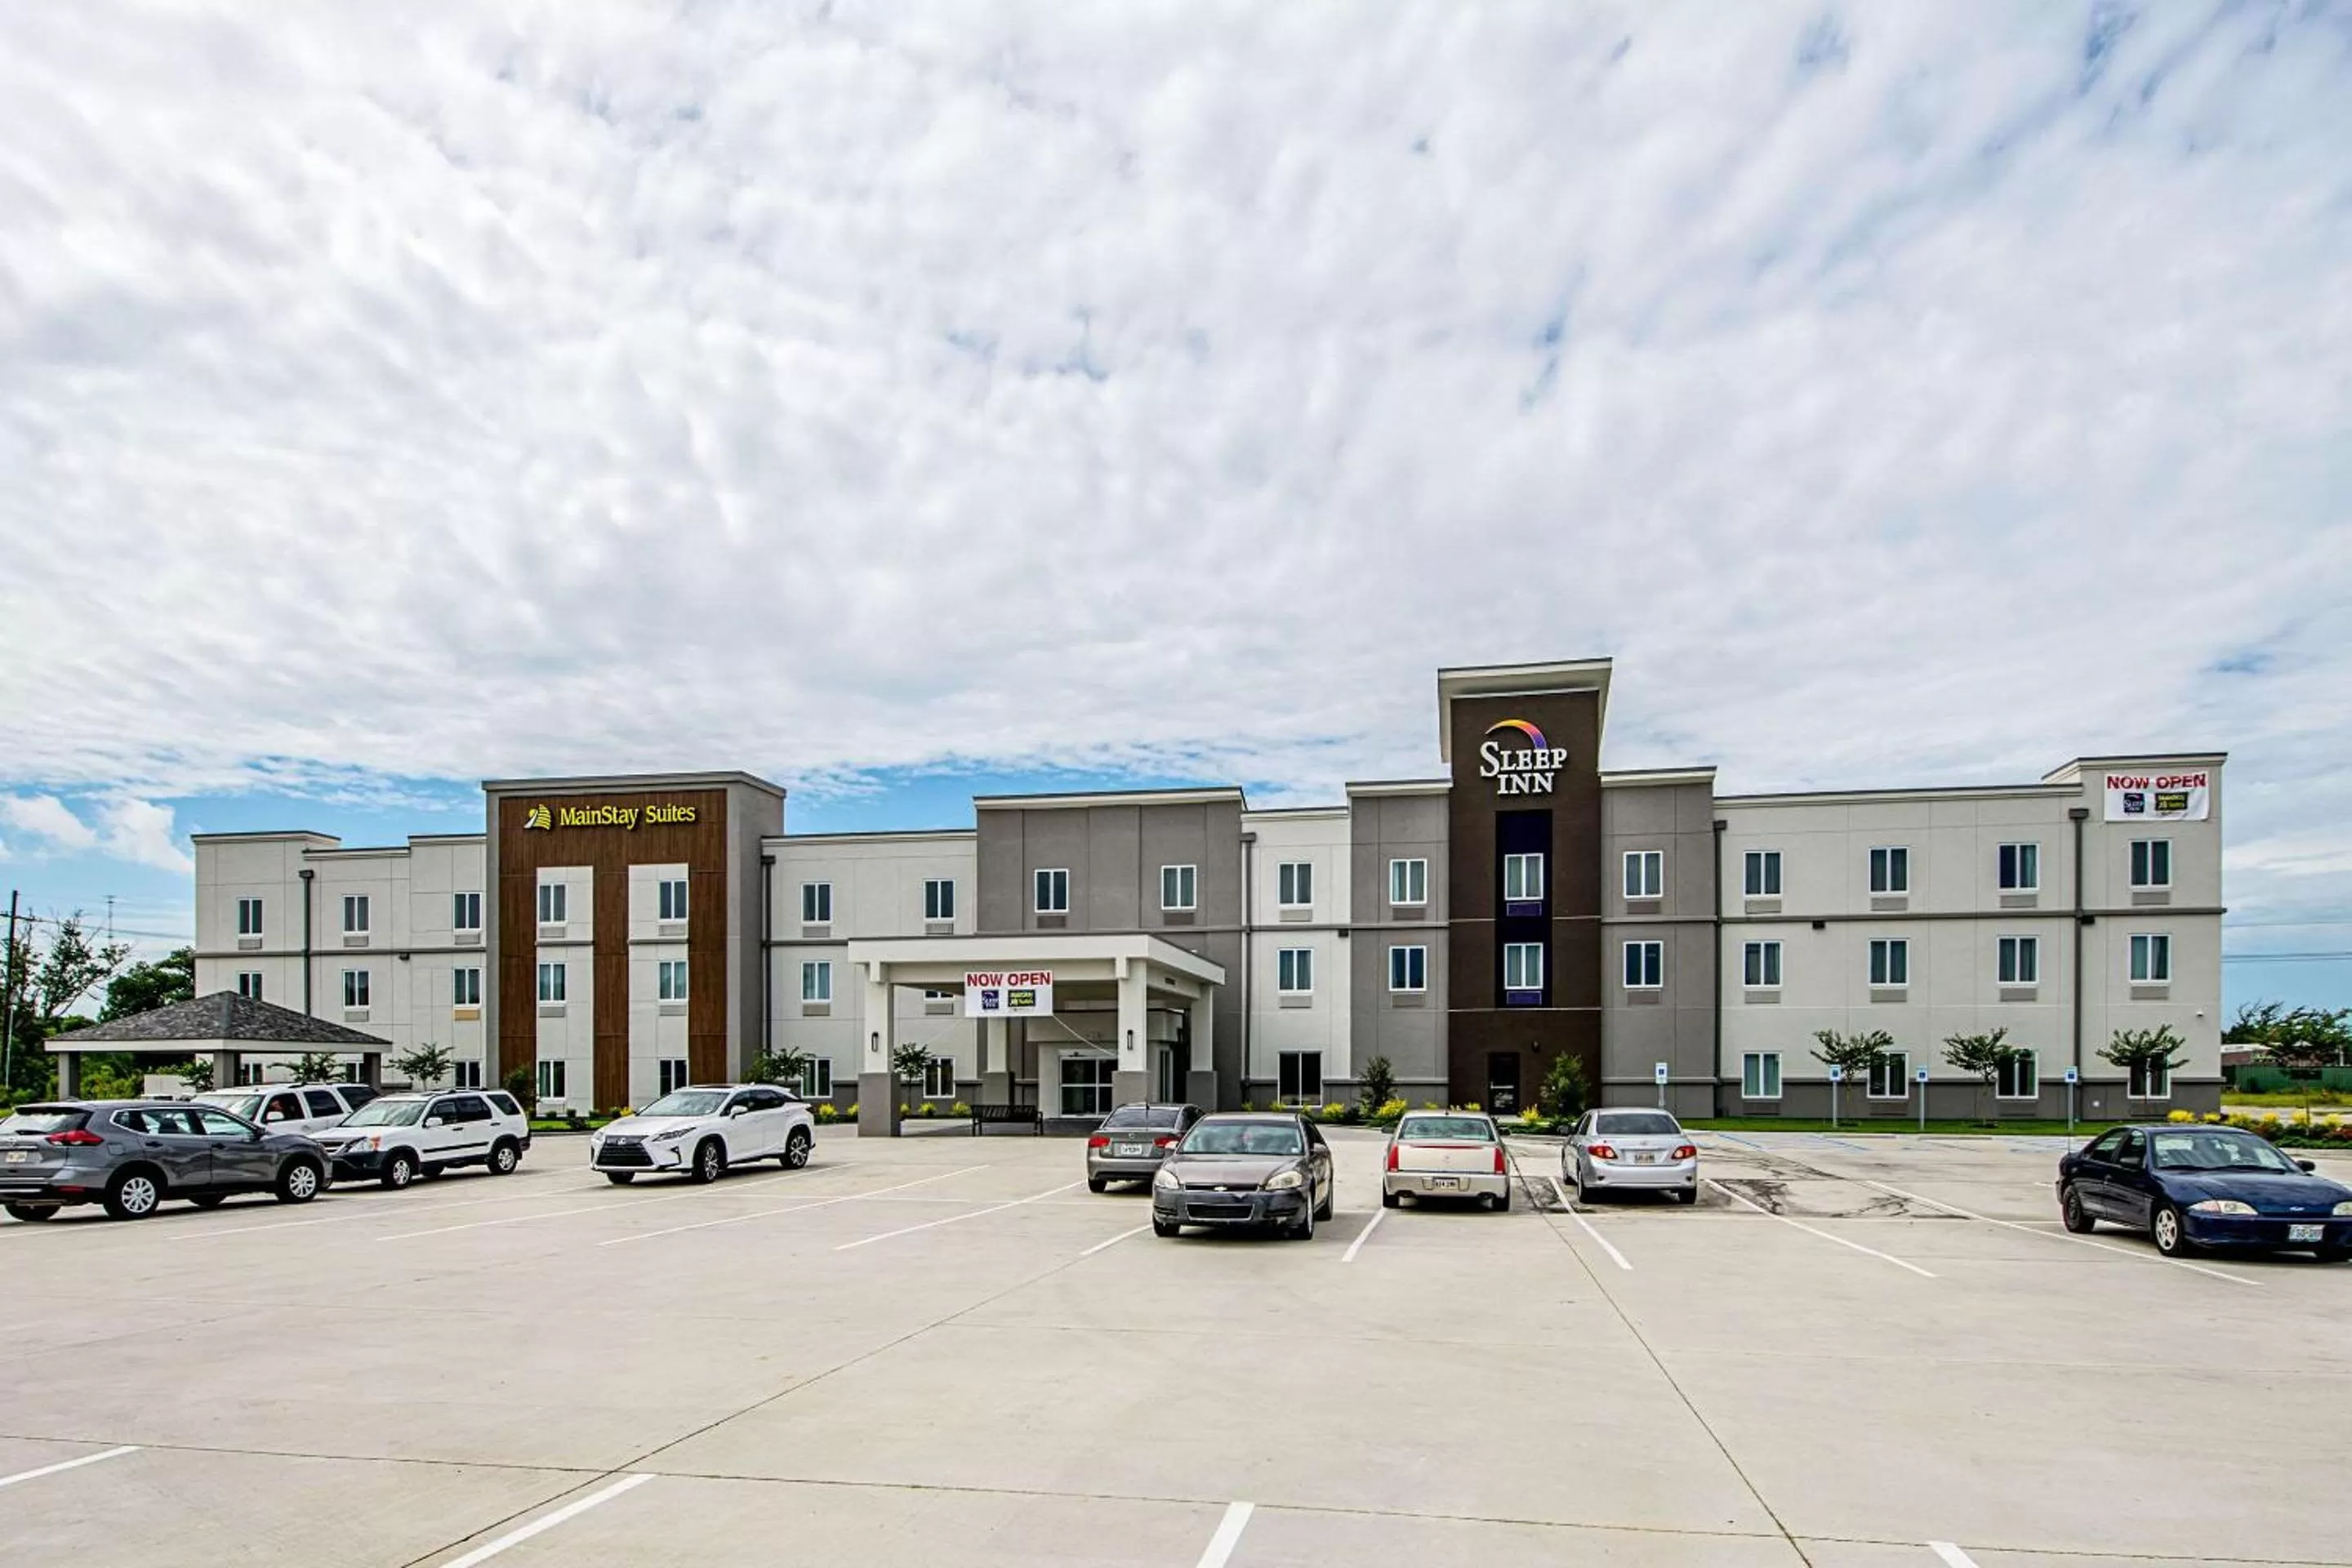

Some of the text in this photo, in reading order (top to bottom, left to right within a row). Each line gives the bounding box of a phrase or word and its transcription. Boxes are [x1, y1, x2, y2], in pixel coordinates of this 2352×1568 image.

[1480, 741, 1567, 777] SLEEP
[1497, 772, 1554, 795] INN
[2107, 773, 2206, 789] NOW OPEN
[560, 803, 696, 831] MainStay Suites
[967, 972, 1050, 987] NOW OPEN
